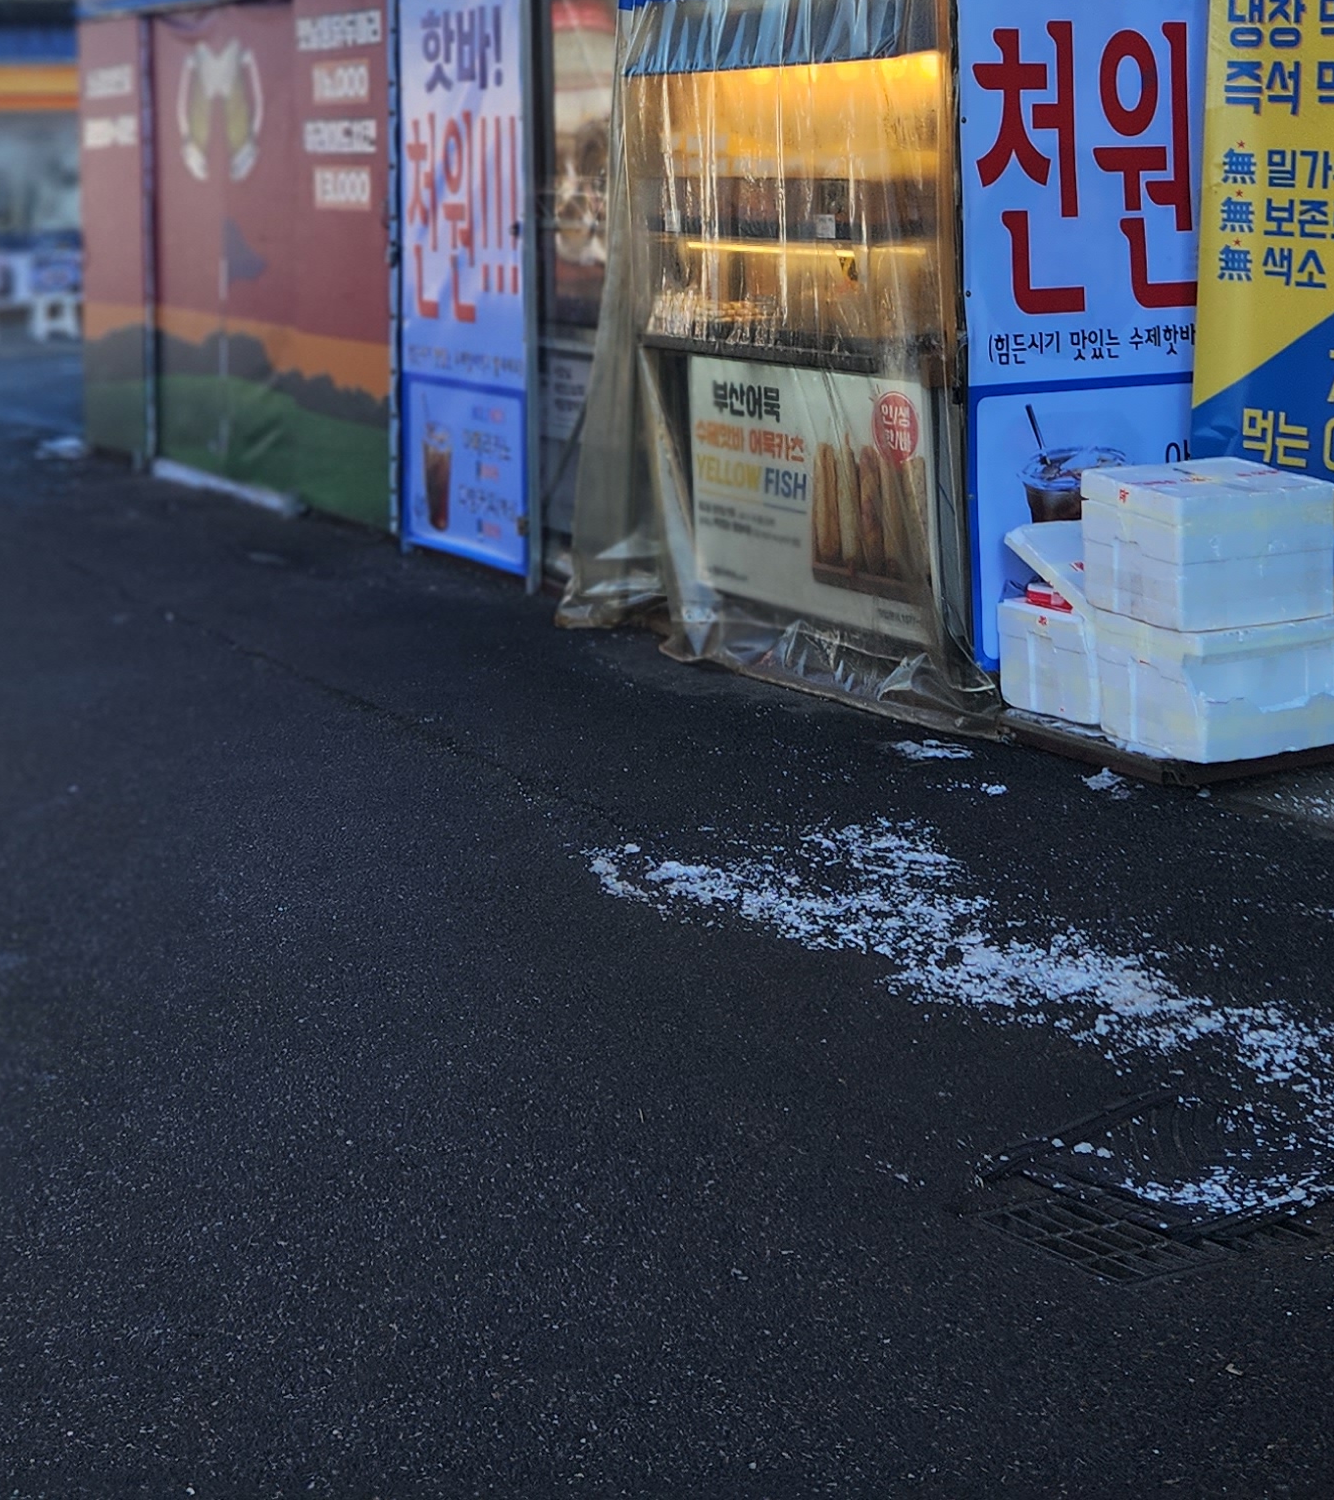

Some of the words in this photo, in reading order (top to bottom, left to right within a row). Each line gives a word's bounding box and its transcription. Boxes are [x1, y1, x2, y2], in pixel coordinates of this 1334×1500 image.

[420, 3, 504, 95] 핫바!
[1223, 59, 1302, 117] 즉석
[1220, 147, 1258, 186] 無
[406, 108, 520, 325] 천원!!!
[1218, 195, 1256, 234] 無
[1216, 243, 1254, 283] 無
[1261, 245, 1328, 290] 색소
[987, 330, 1061, 367] (힘든시기
[1069, 327, 1121, 363] 맛있는
[712, 379, 781, 423] 부산어묵
[748, 427, 805, 463] 어묵카츠
[1241, 406, 1312, 469] 먹는
[696, 452, 763, 493] YELLOW
[763, 466, 808, 501] FISH
